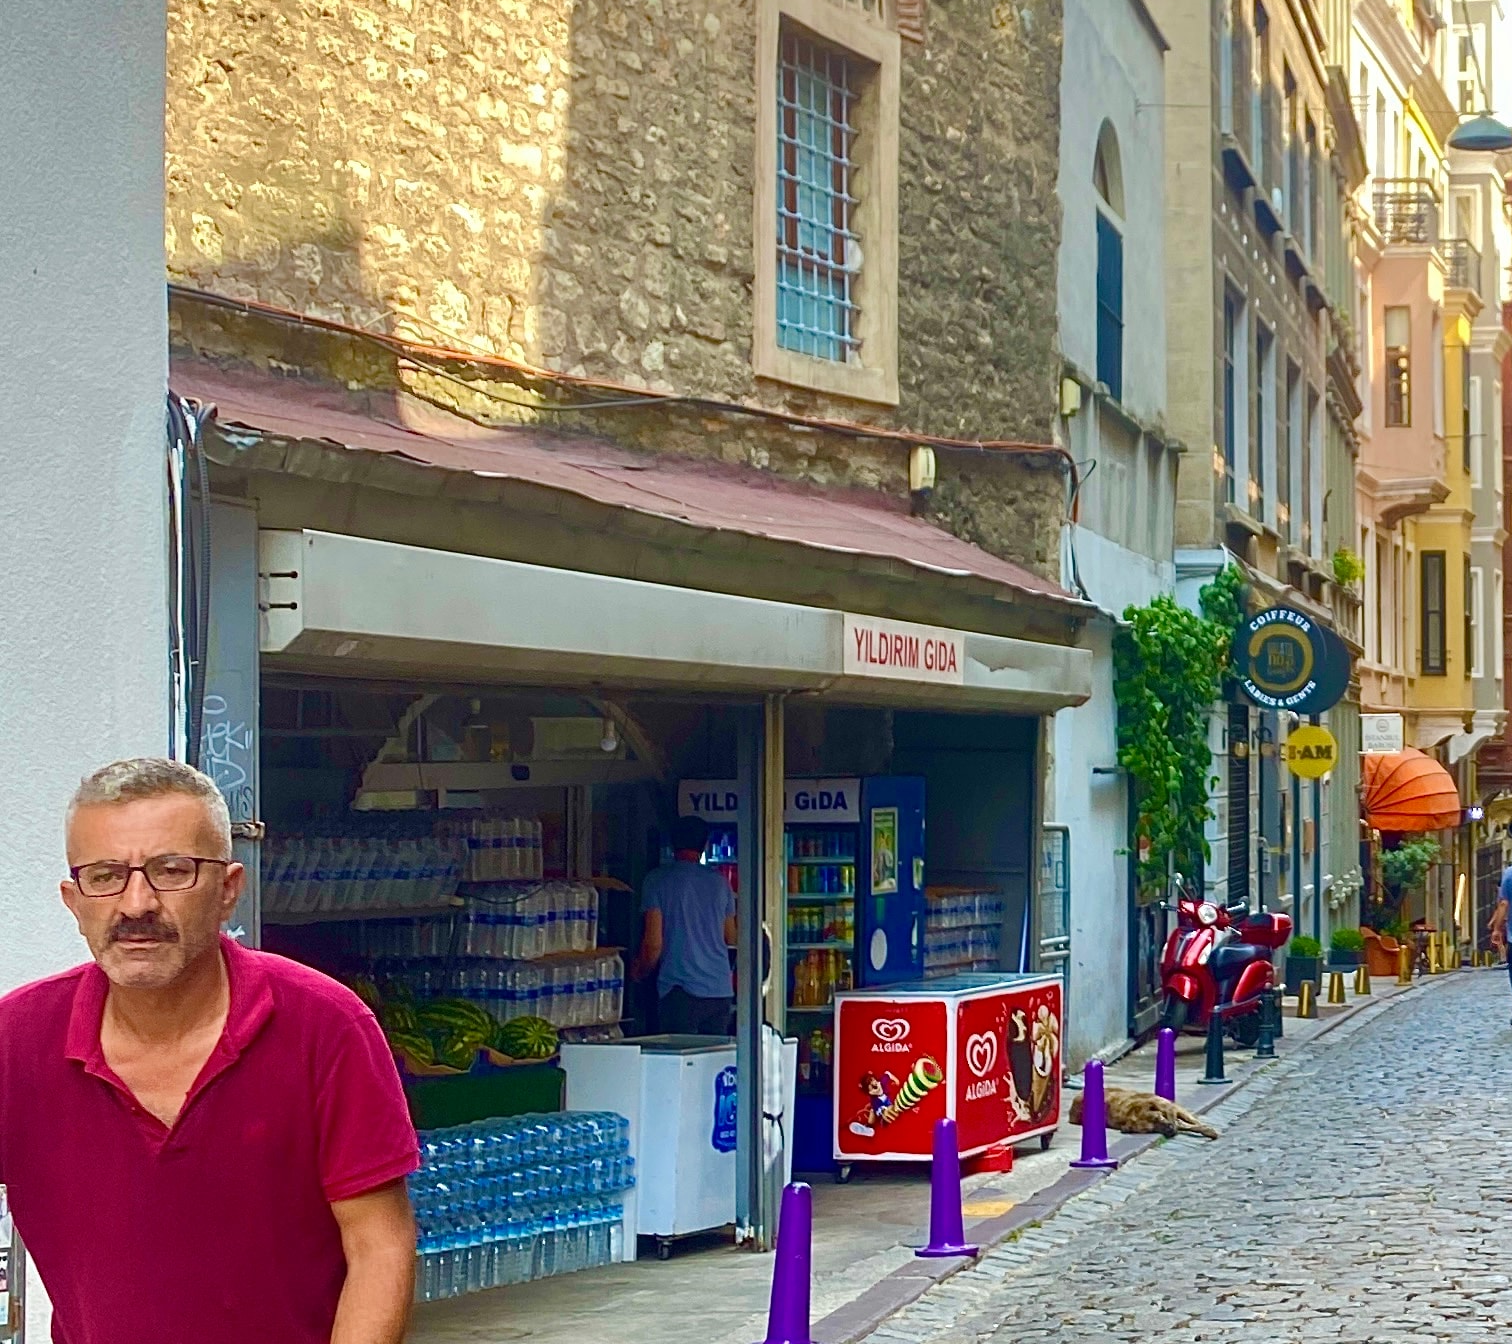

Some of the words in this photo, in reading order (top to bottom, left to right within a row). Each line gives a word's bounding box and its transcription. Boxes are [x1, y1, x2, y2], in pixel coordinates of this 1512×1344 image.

[1249, 609, 1311, 633] COIFFEUR
[854, 627, 919, 669] YILDIRIM
[924, 639, 957, 673] GIDA
[1244, 679, 1277, 706] LADIES
[1285, 680, 1316, 706] GENTS
